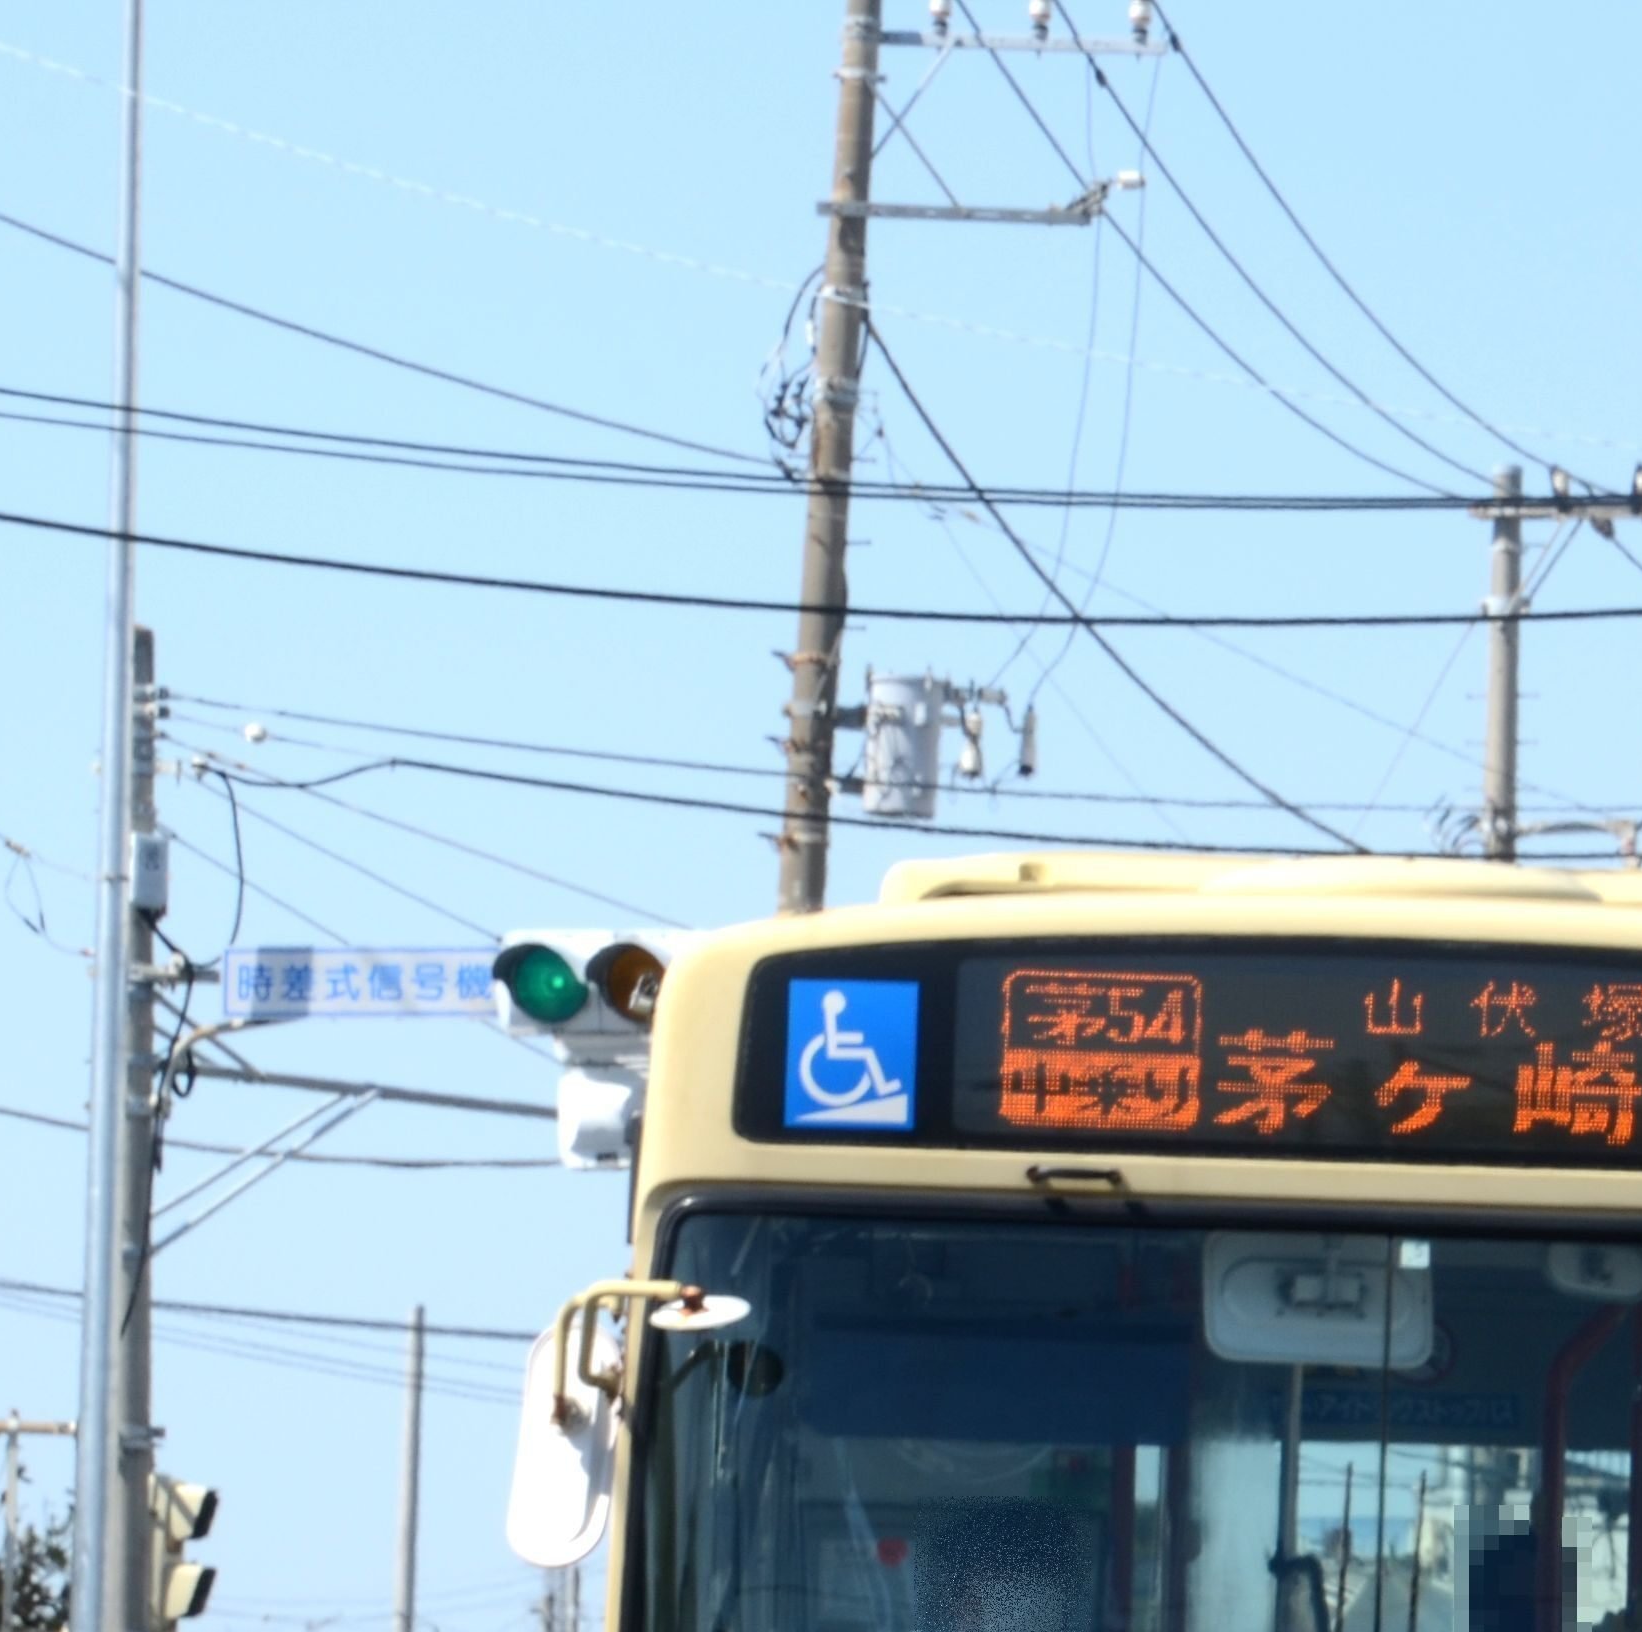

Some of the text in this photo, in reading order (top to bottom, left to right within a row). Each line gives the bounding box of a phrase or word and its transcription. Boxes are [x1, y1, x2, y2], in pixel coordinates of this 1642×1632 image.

[238, 963, 494, 1001] 時差式信号機
[1024, 982, 1185, 1045] 茅54
